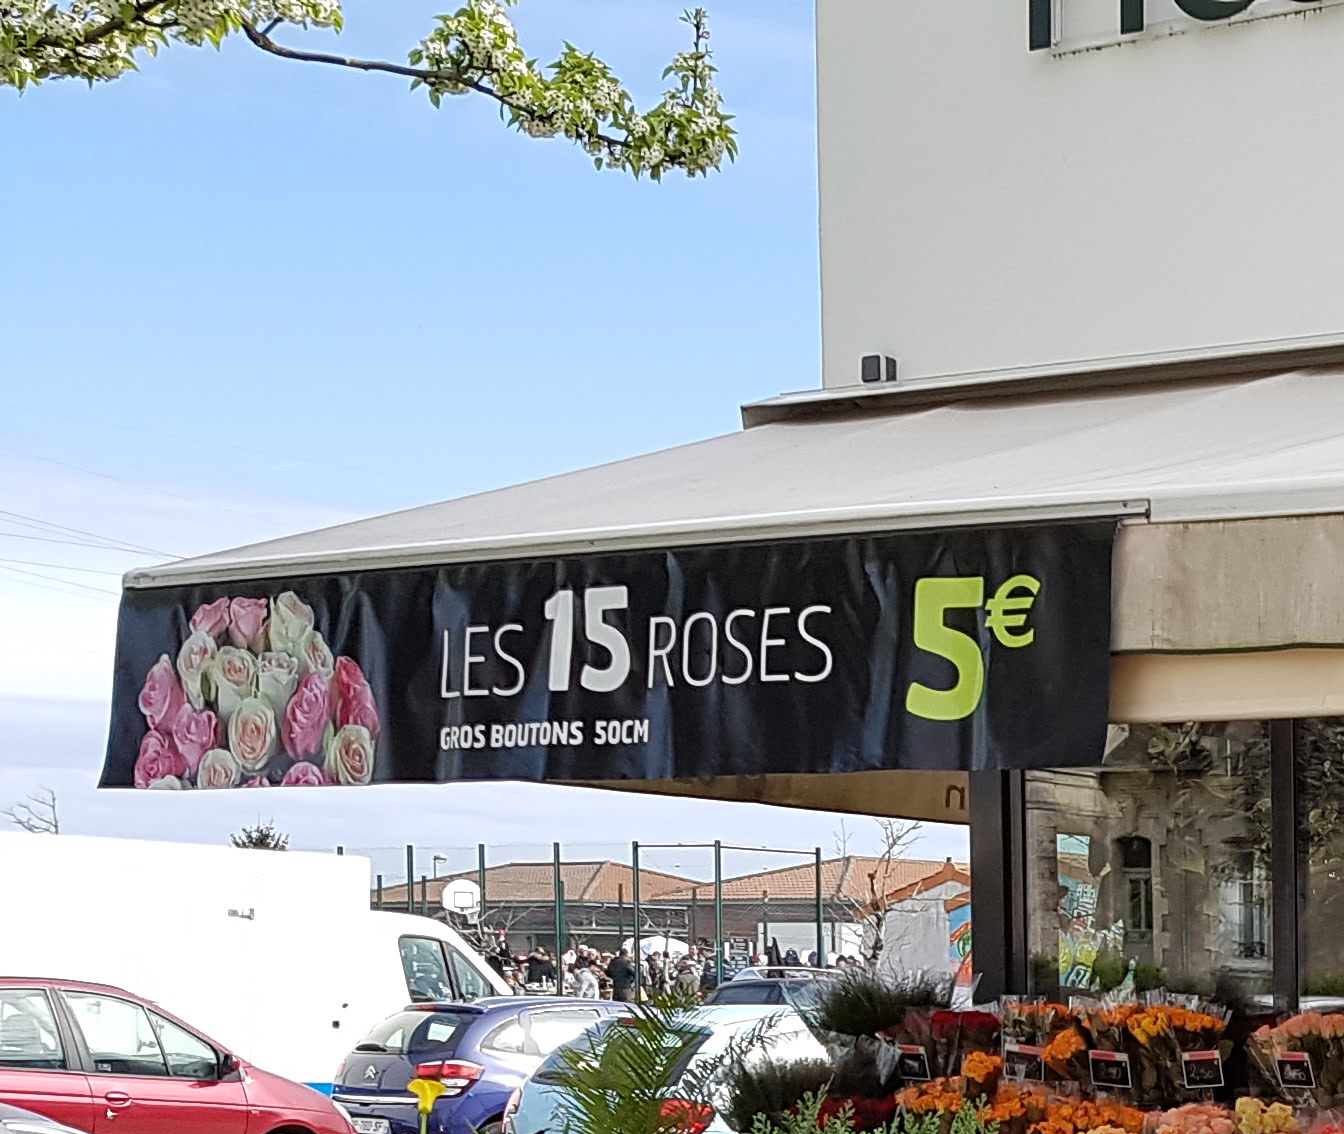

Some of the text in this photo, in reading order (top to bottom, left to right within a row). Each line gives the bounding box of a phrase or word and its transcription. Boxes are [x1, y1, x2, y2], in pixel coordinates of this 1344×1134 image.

[440, 622, 524, 699] LES
[544, 585, 630, 692] 15
[648, 605, 833, 687] ROSES
[440, 718, 649, 750] GROS BOUTONS 50CM
